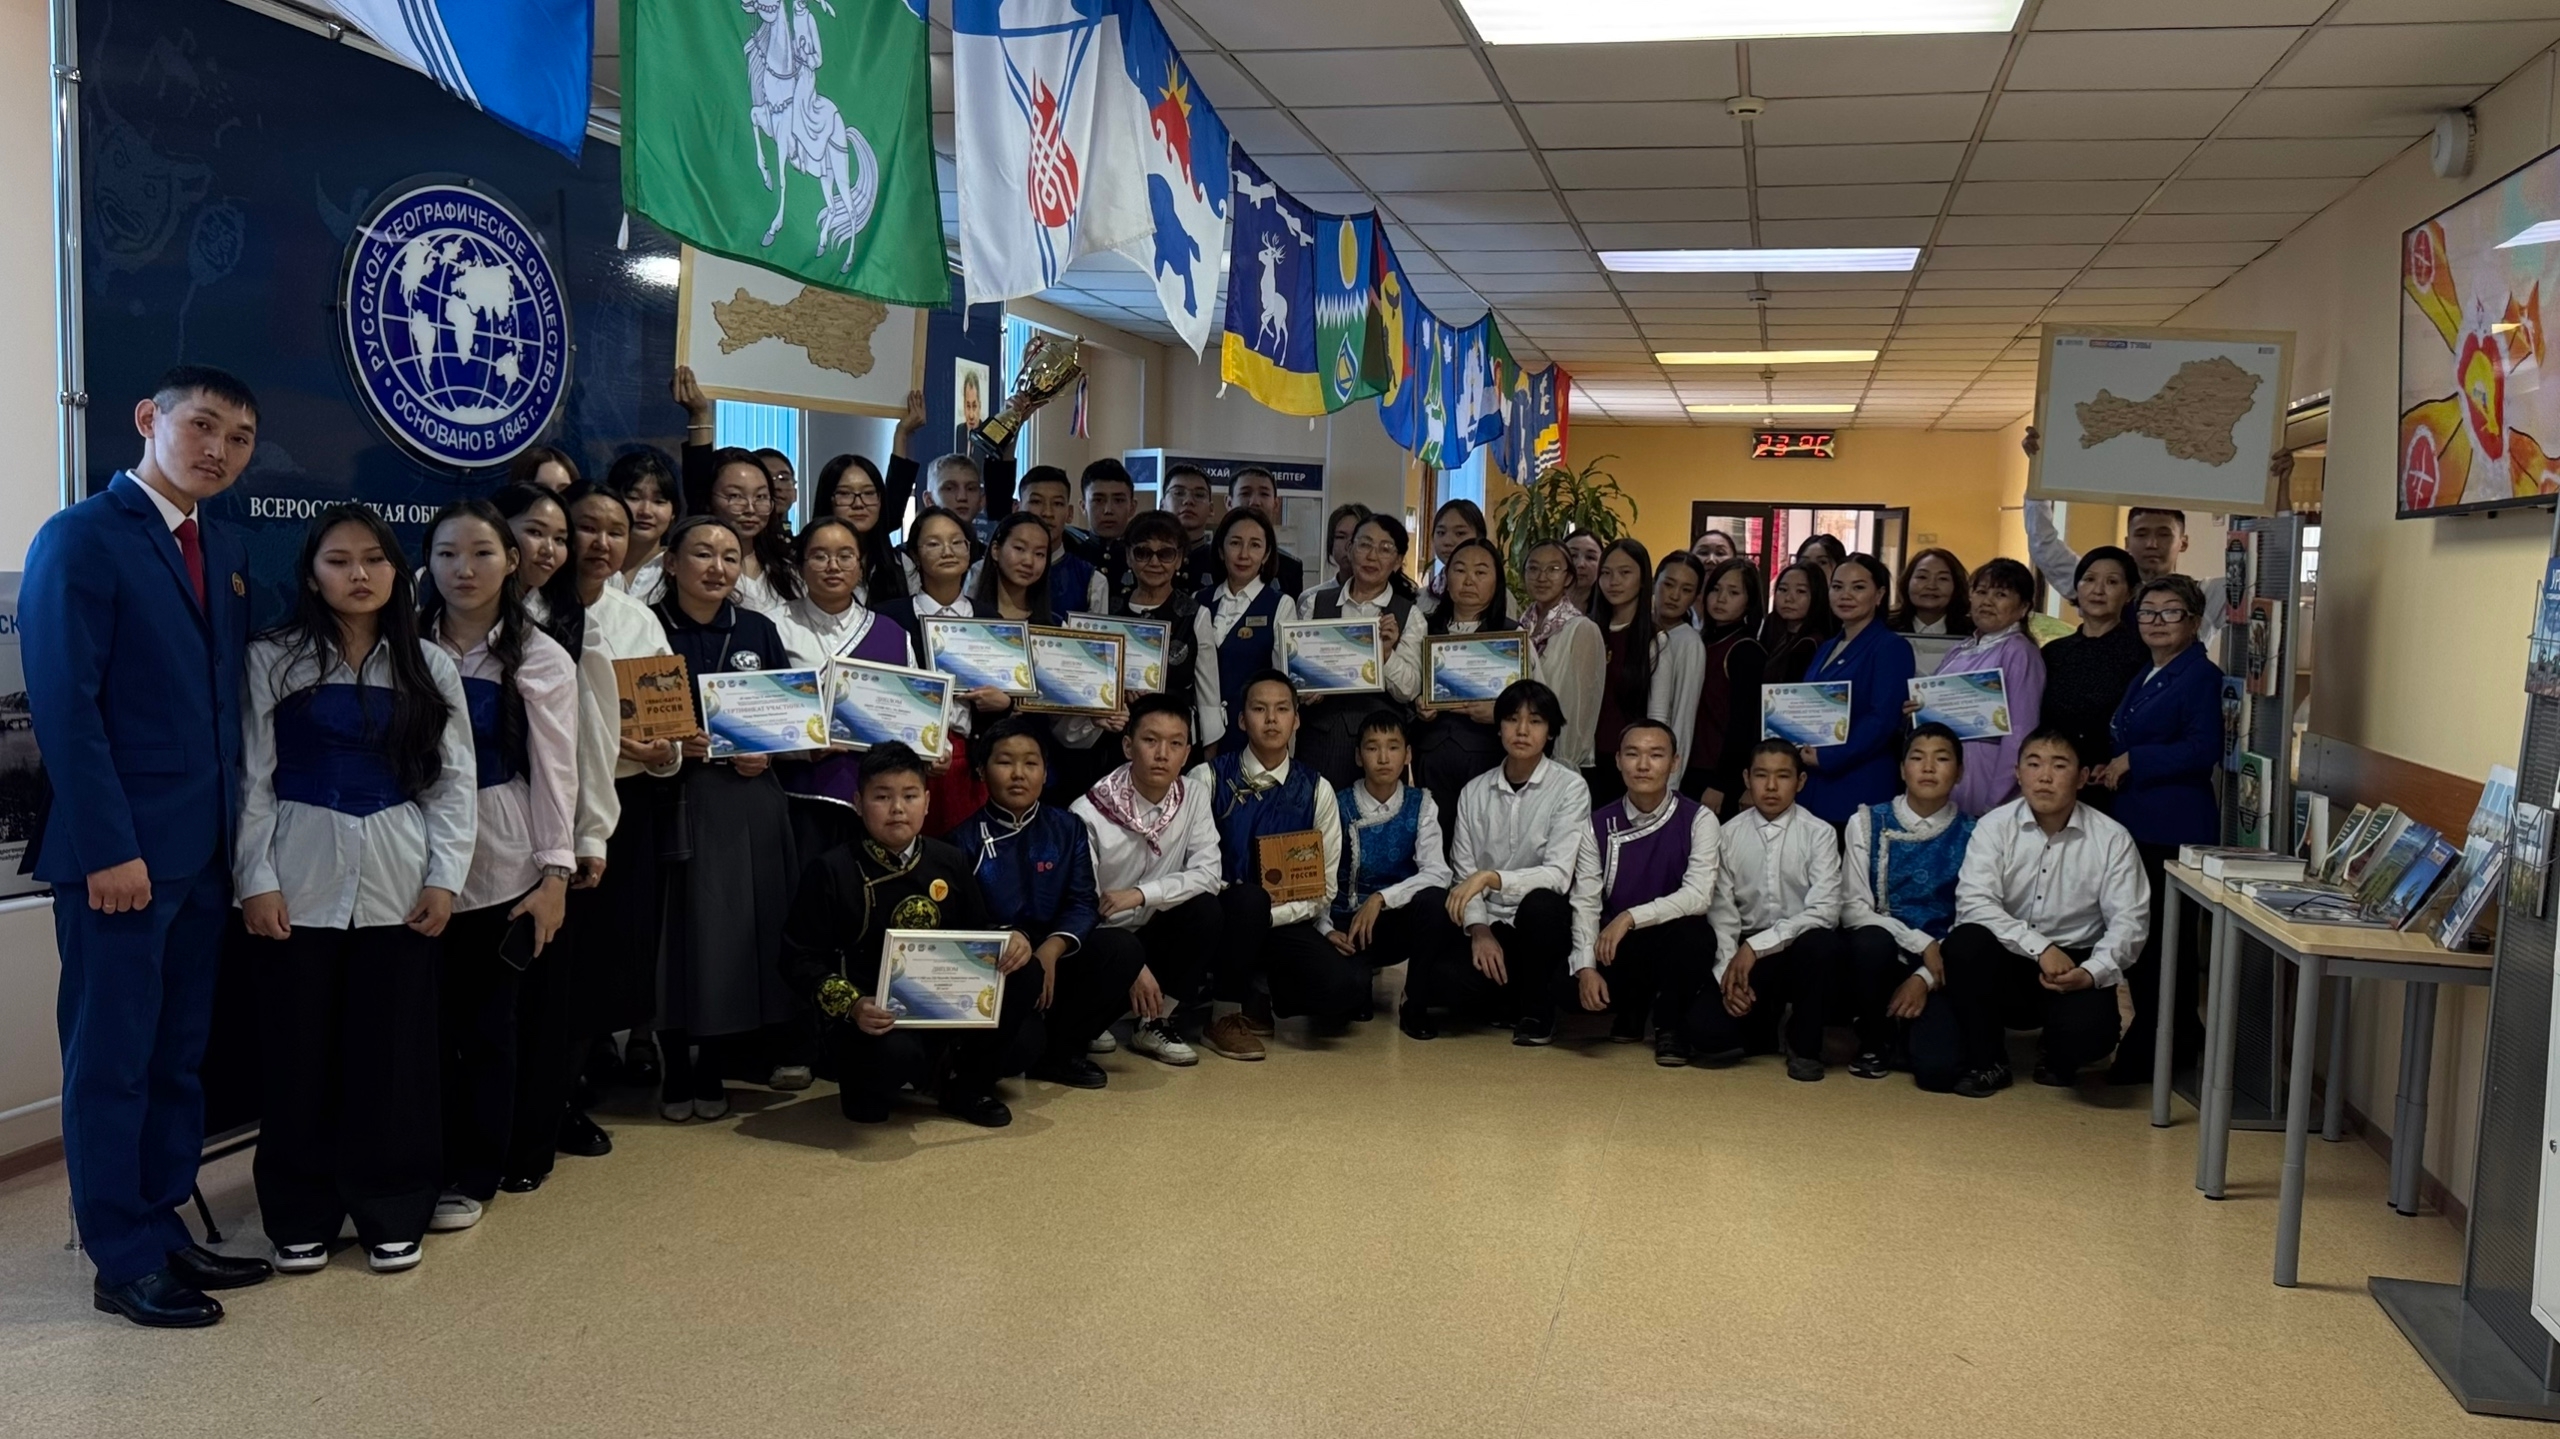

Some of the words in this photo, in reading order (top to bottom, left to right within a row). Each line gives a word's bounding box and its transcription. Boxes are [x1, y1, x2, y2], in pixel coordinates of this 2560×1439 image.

[360, 242, 389, 372] РУССКОЕ
[384, 202, 527, 262] ГЕОГРАФИЧЕСКОЕ
[526, 257, 558, 394] ОБЩЕСТВО
[392, 389, 482, 452] ОСНОВАНО
[485, 431, 496, 450] В
[499, 414, 530, 445] 1845
[250, 497, 406, 523] ВСЕРОСКАЯ
[646, 704, 684, 715] РОССИИ
